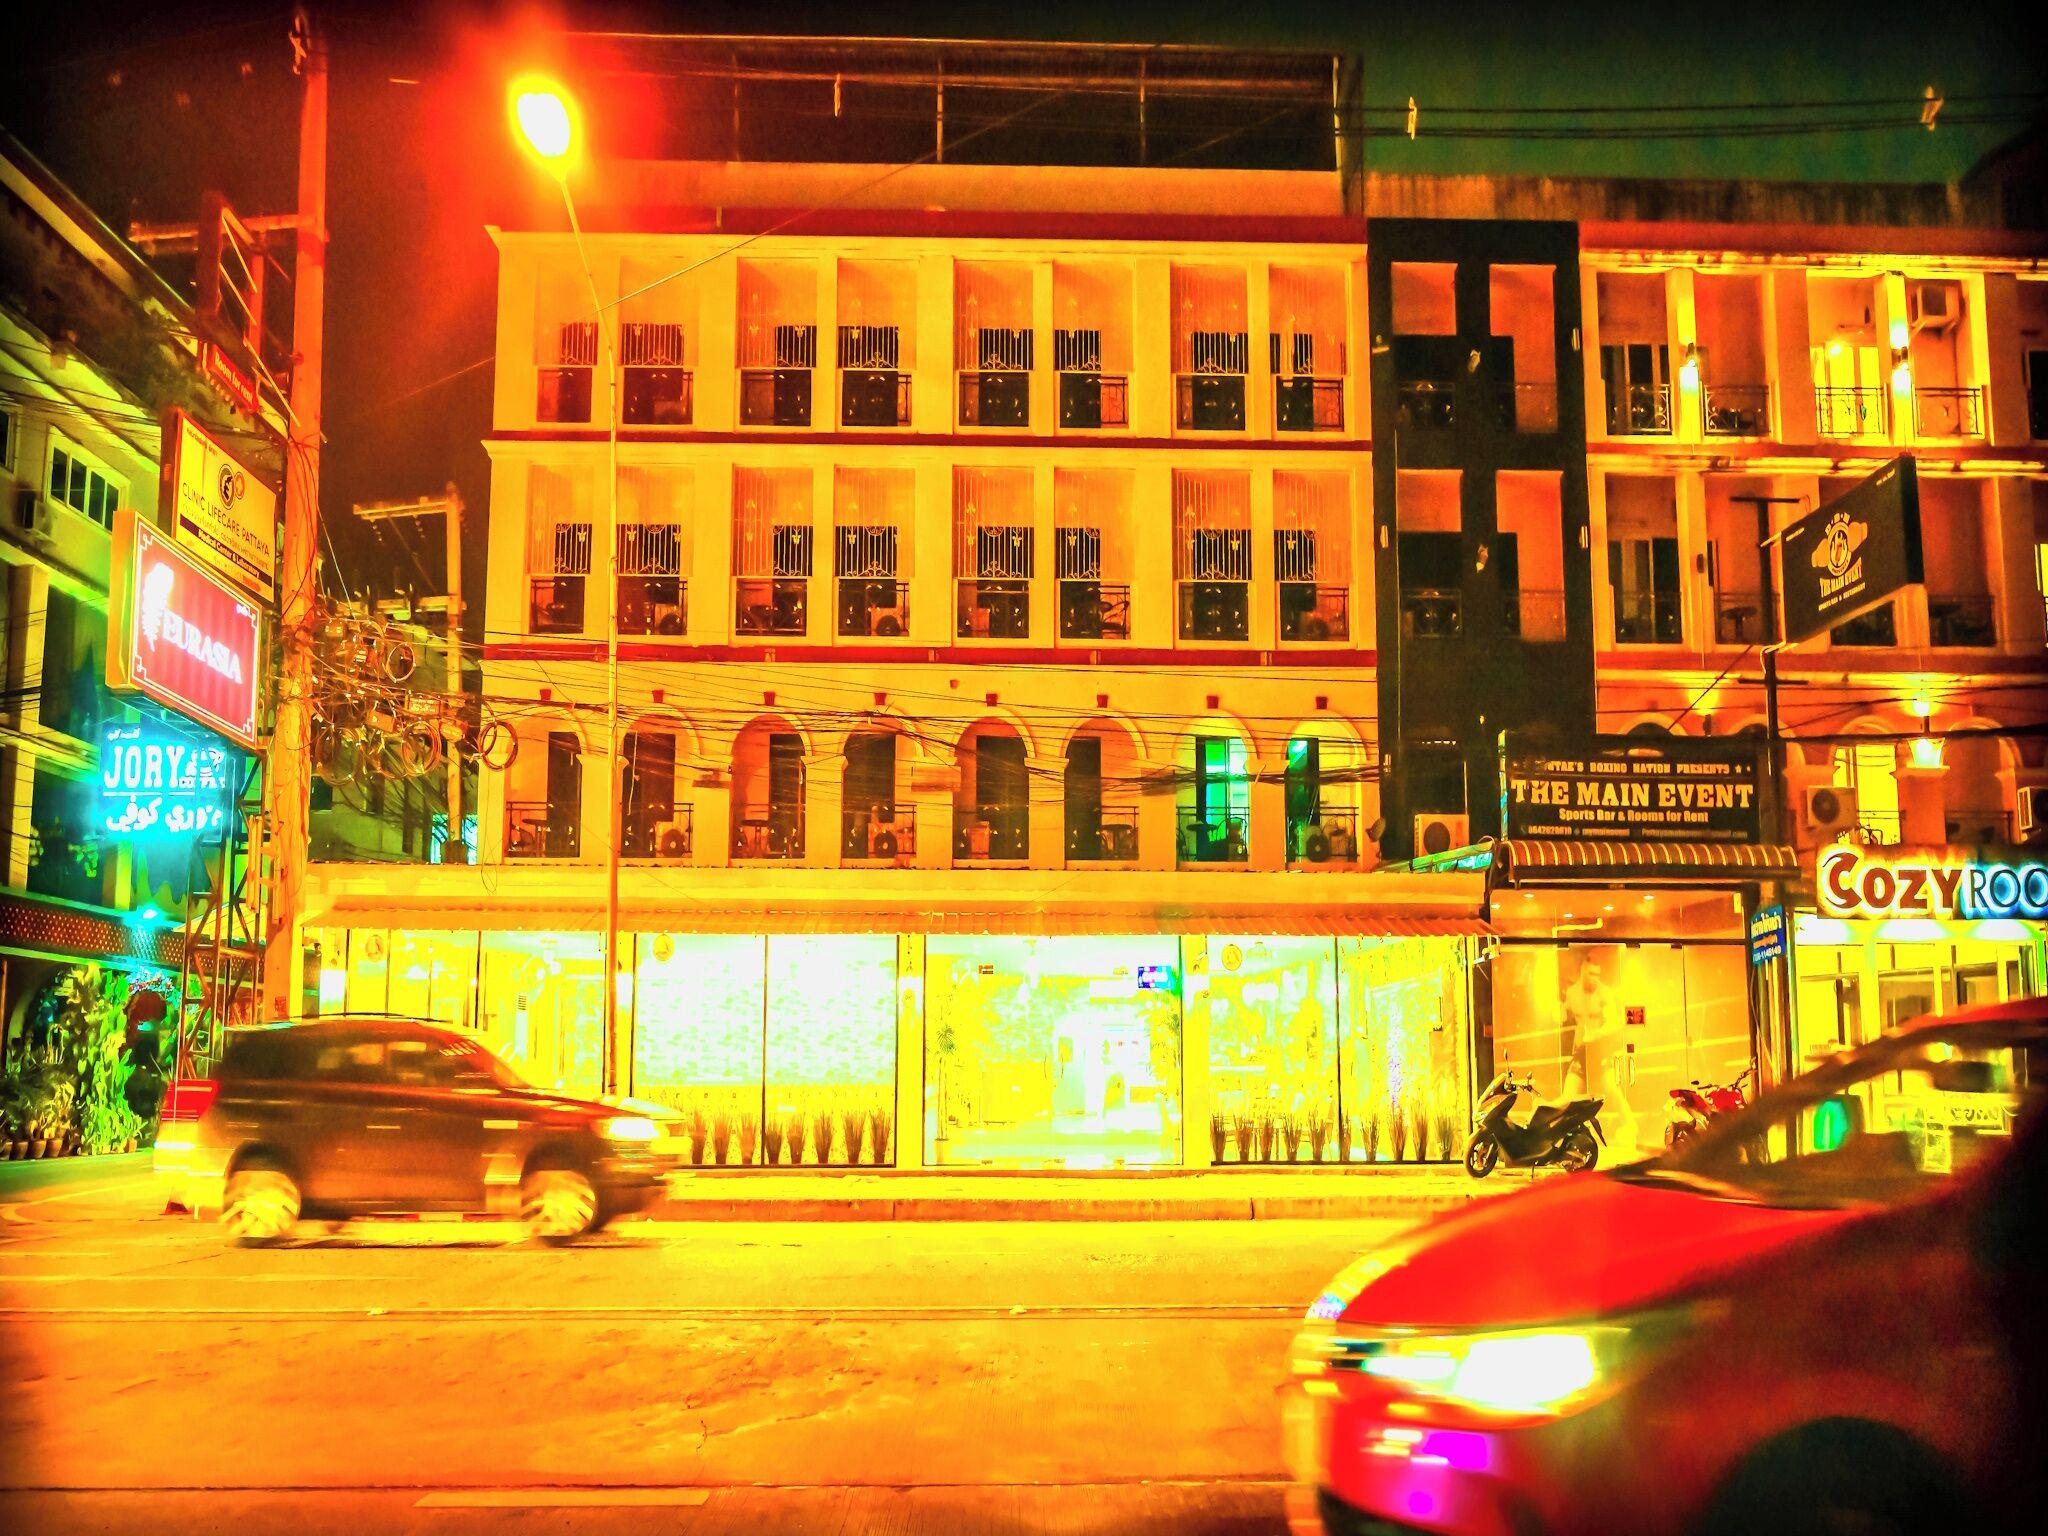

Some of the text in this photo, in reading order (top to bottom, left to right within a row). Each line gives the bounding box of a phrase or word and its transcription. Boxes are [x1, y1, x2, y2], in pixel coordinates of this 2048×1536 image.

[182, 482, 205, 512] CLINIC
[207, 505, 240, 538] LIFECARE
[241, 528, 270, 558] PATTAYA
[198, 528, 217, 549] Medical
[216, 540, 232, 560] Center
[236, 553, 260, 579] Laboratory
[1844, 557, 1863, 586] EVENT
[161, 609, 243, 684] EURASIA
[103, 744, 186, 789] JORY
[1589, 762, 1628, 773] BOXING
[1632, 763, 1671, 774] NATION
[1676, 764, 1730, 775] PRESENTS
[1510, 779, 1754, 808] THE MAIN EVENT
[1559, 808, 1709, 823] Sports Bar & Rooms for Rent
